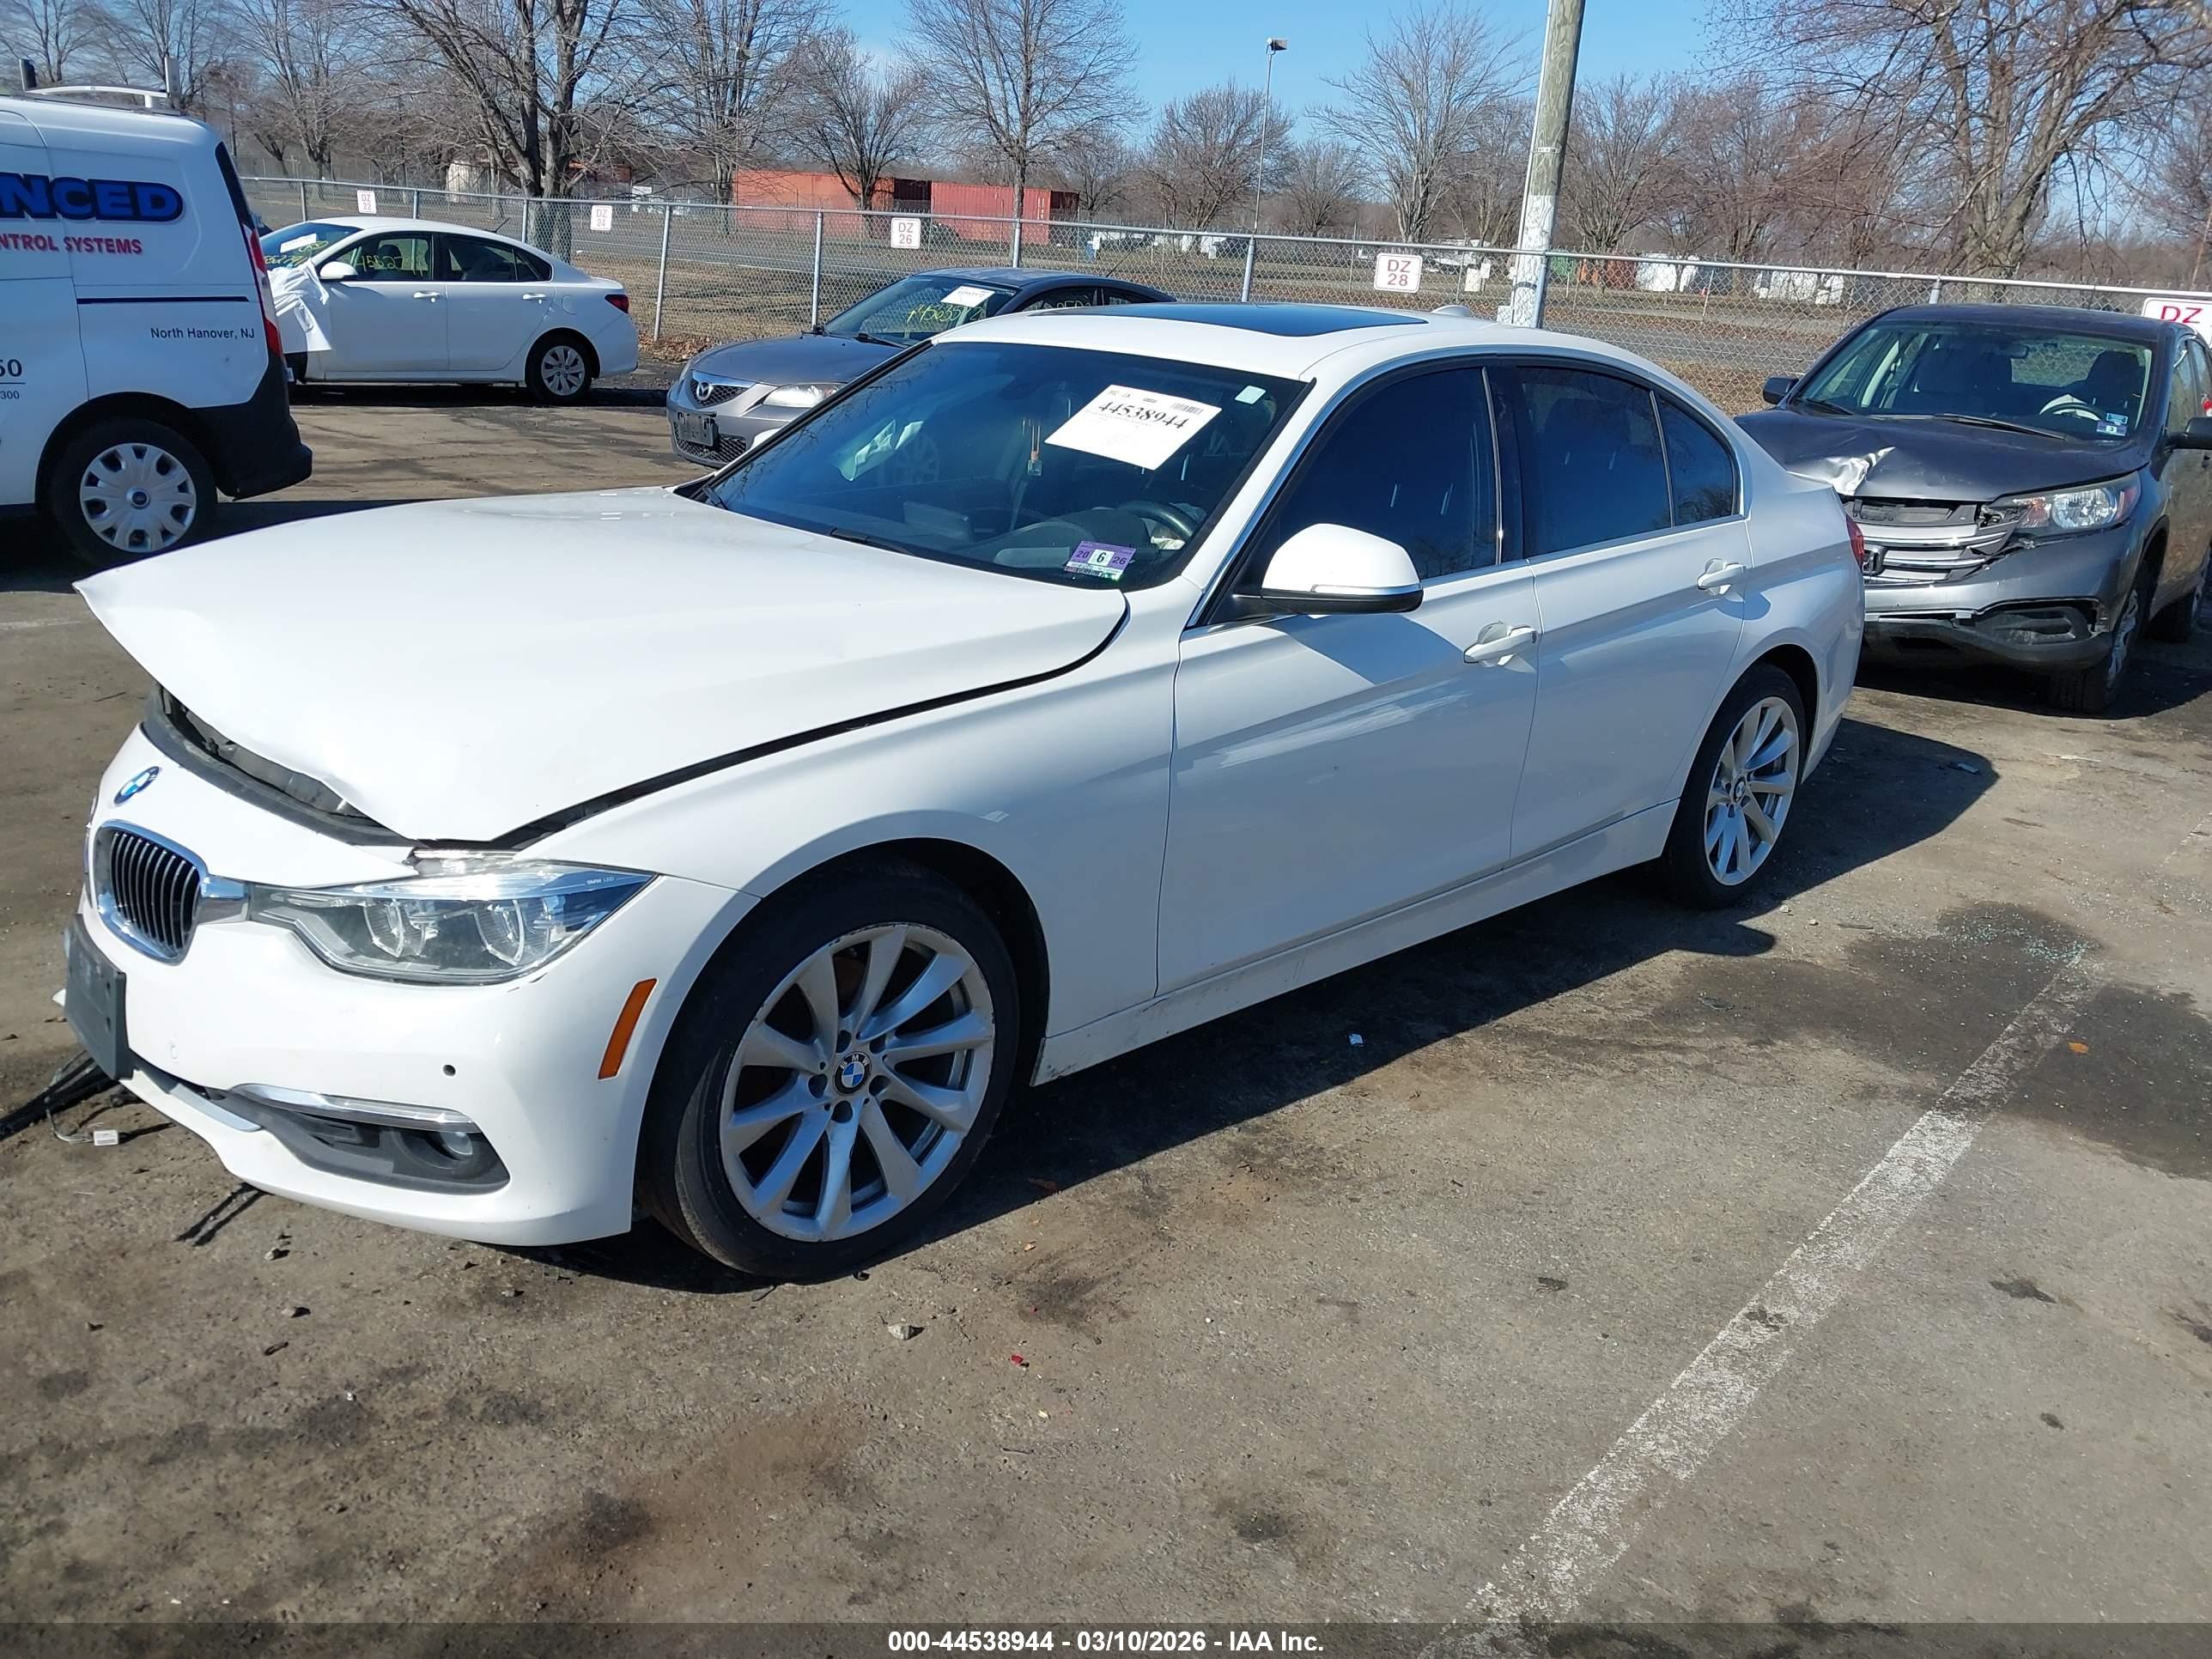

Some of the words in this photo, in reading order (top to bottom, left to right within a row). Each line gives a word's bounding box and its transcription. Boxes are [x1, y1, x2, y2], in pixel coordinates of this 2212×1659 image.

[362, 193, 371, 202] DZ
[597, 209, 607, 218] DZ
[898, 222, 914, 233] DZ
[64, 236, 143, 254] SYSTEMS
[899, 234, 913, 244] 26
[1388, 259, 1411, 273] DZ
[1387, 273, 1408, 286] 28
[2160, 306, 2203, 323] DZ
[150, 328, 184, 338] North
[187, 328, 238, 339] Hanover,
[240, 328, 255, 338] NJ
[1098, 401, 1189, 429] 44538944
[1076, 550, 1091, 559] 20
[1097, 552, 1106, 563] 6
[1111, 556, 1127, 565] 26
[840, 1054, 869, 1069] BMW
